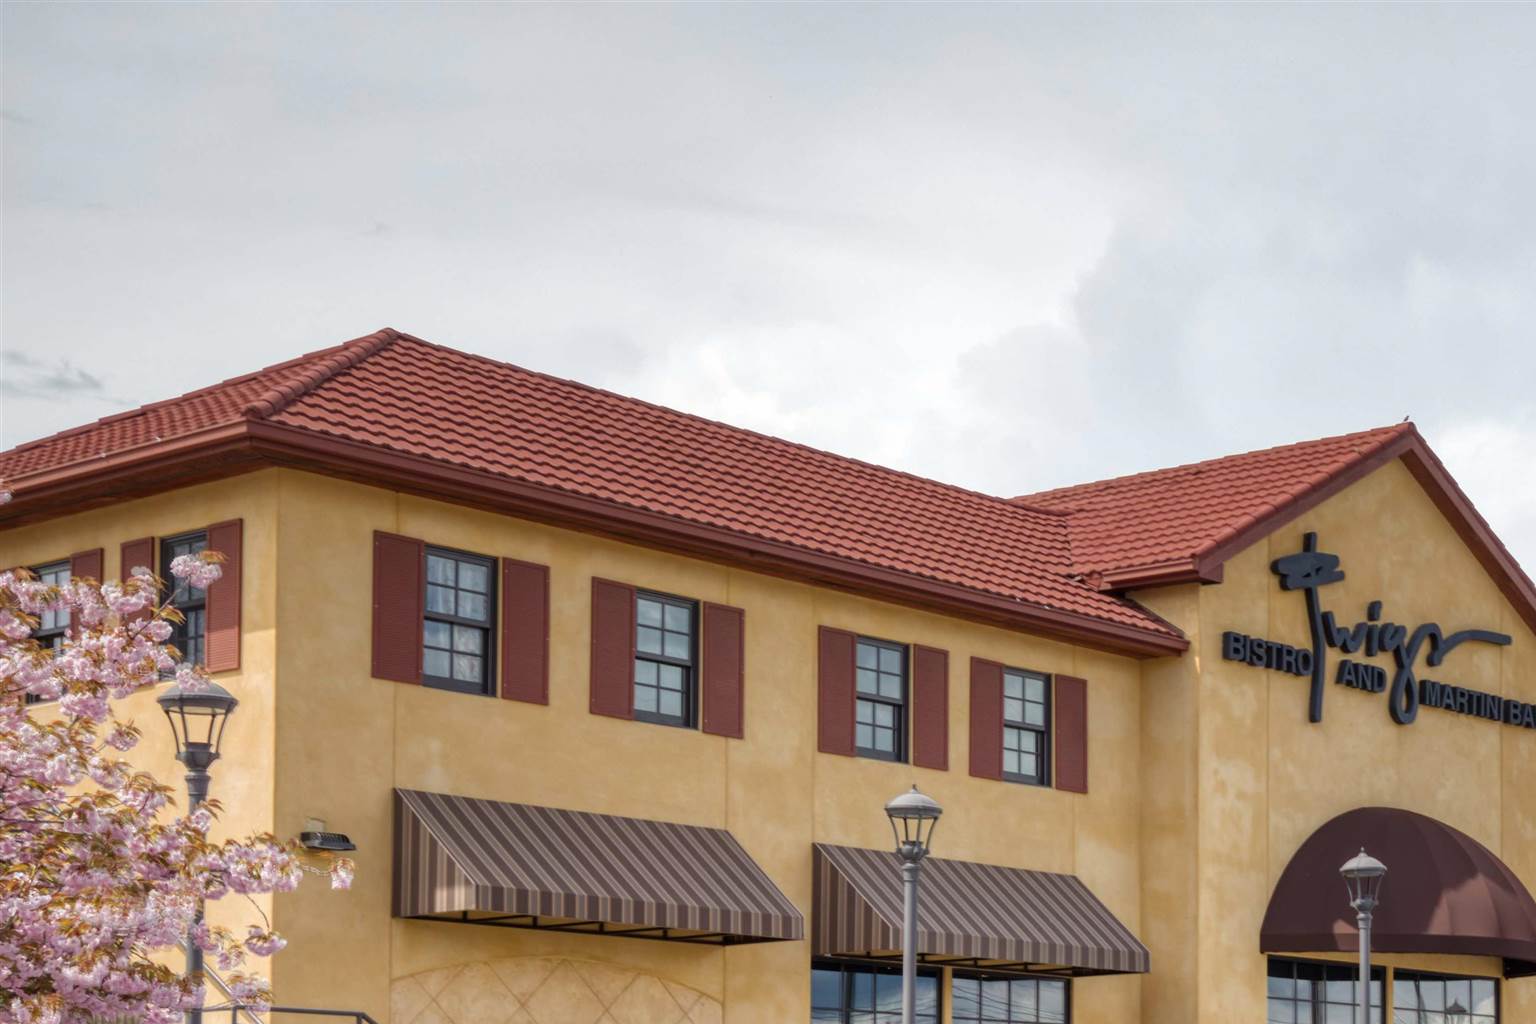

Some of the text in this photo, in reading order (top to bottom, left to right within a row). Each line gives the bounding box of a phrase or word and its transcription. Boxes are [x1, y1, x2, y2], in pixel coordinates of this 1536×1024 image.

[1223, 631, 1314, 677] BISTRO
[1336, 659, 1387, 693] AND
[1419, 680, 1503, 721] MARTINI
